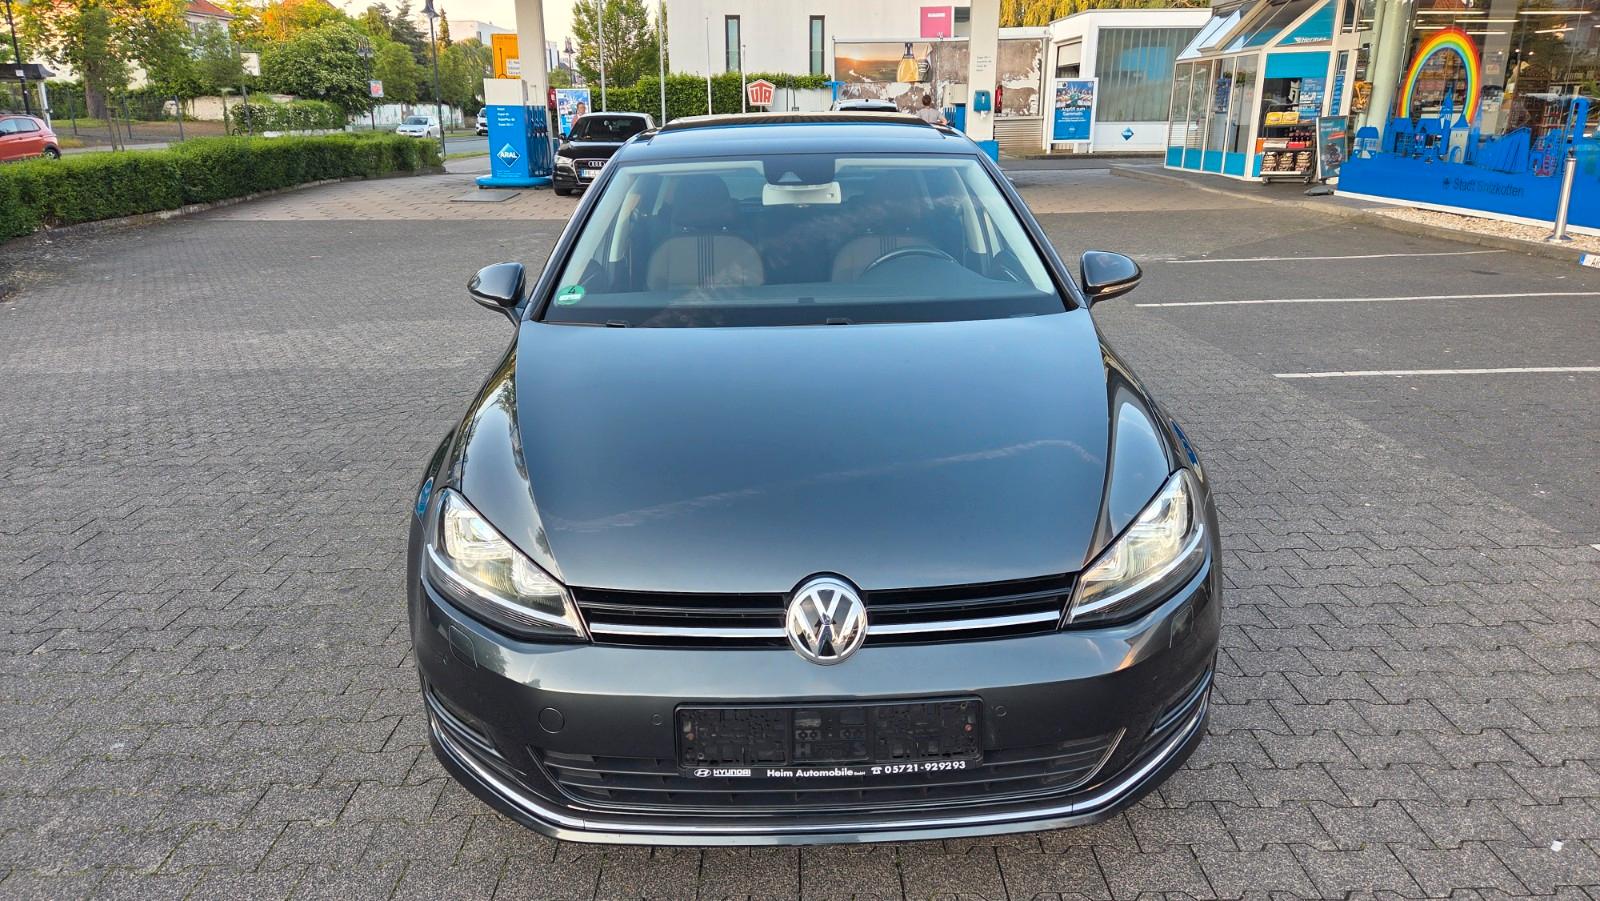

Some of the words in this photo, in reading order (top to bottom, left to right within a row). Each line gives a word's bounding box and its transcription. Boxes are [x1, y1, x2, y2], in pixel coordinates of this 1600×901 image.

[749, 82, 774, 104] UTA
[568, 286, 576, 294] 4
[713, 769, 751, 777] HYUNDAI
[766, 769, 793, 777] Heim
[795, 767, 854, 777] Automobile
[884, 760, 966, 774] 05721-929293
